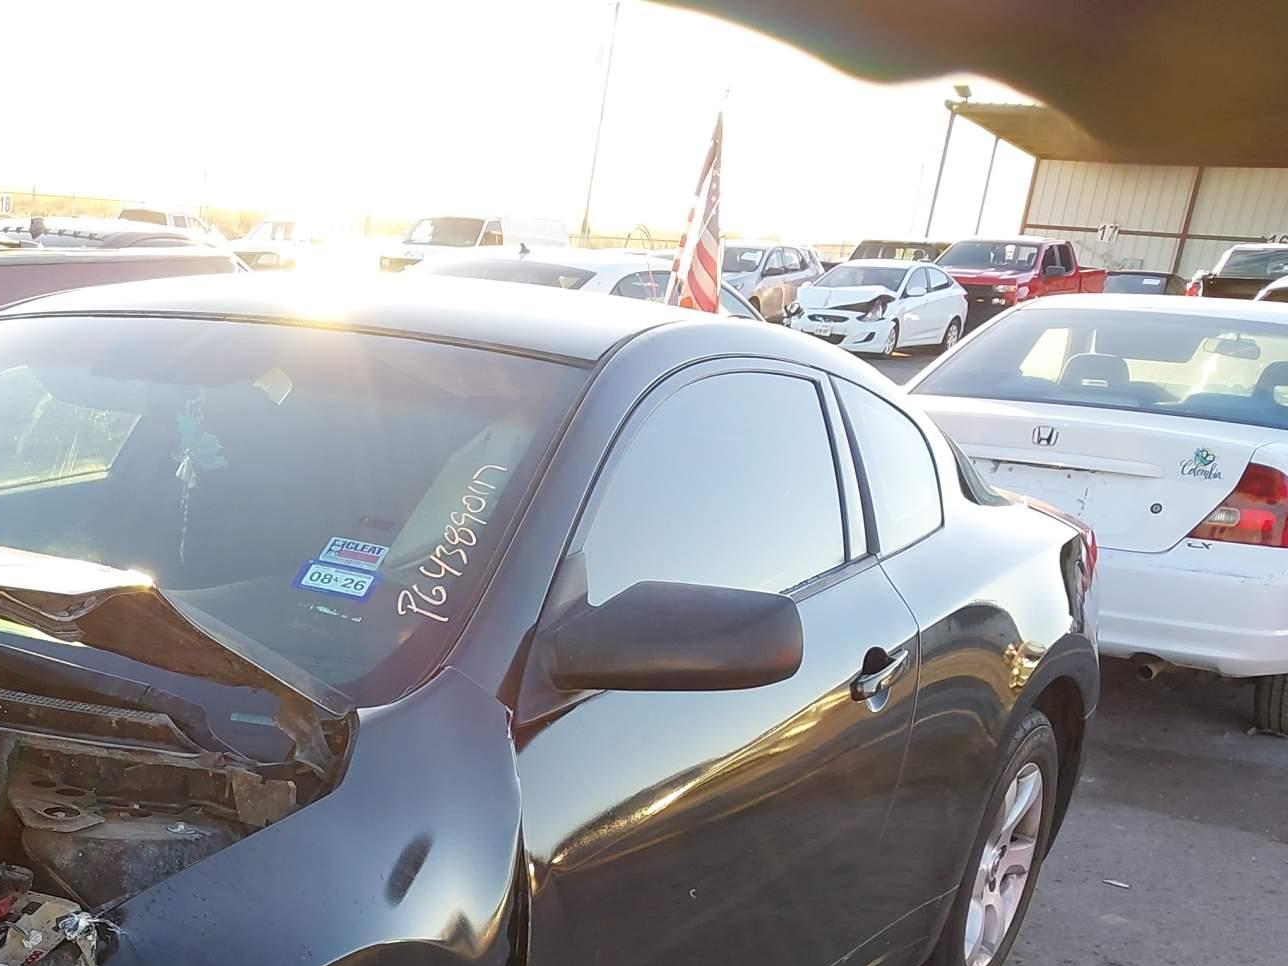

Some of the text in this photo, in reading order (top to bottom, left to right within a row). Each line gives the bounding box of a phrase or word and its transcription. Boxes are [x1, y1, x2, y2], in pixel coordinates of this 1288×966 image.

[1180, 459, 1224, 480] Colombia
[309, 571, 367, 591] 08 26
